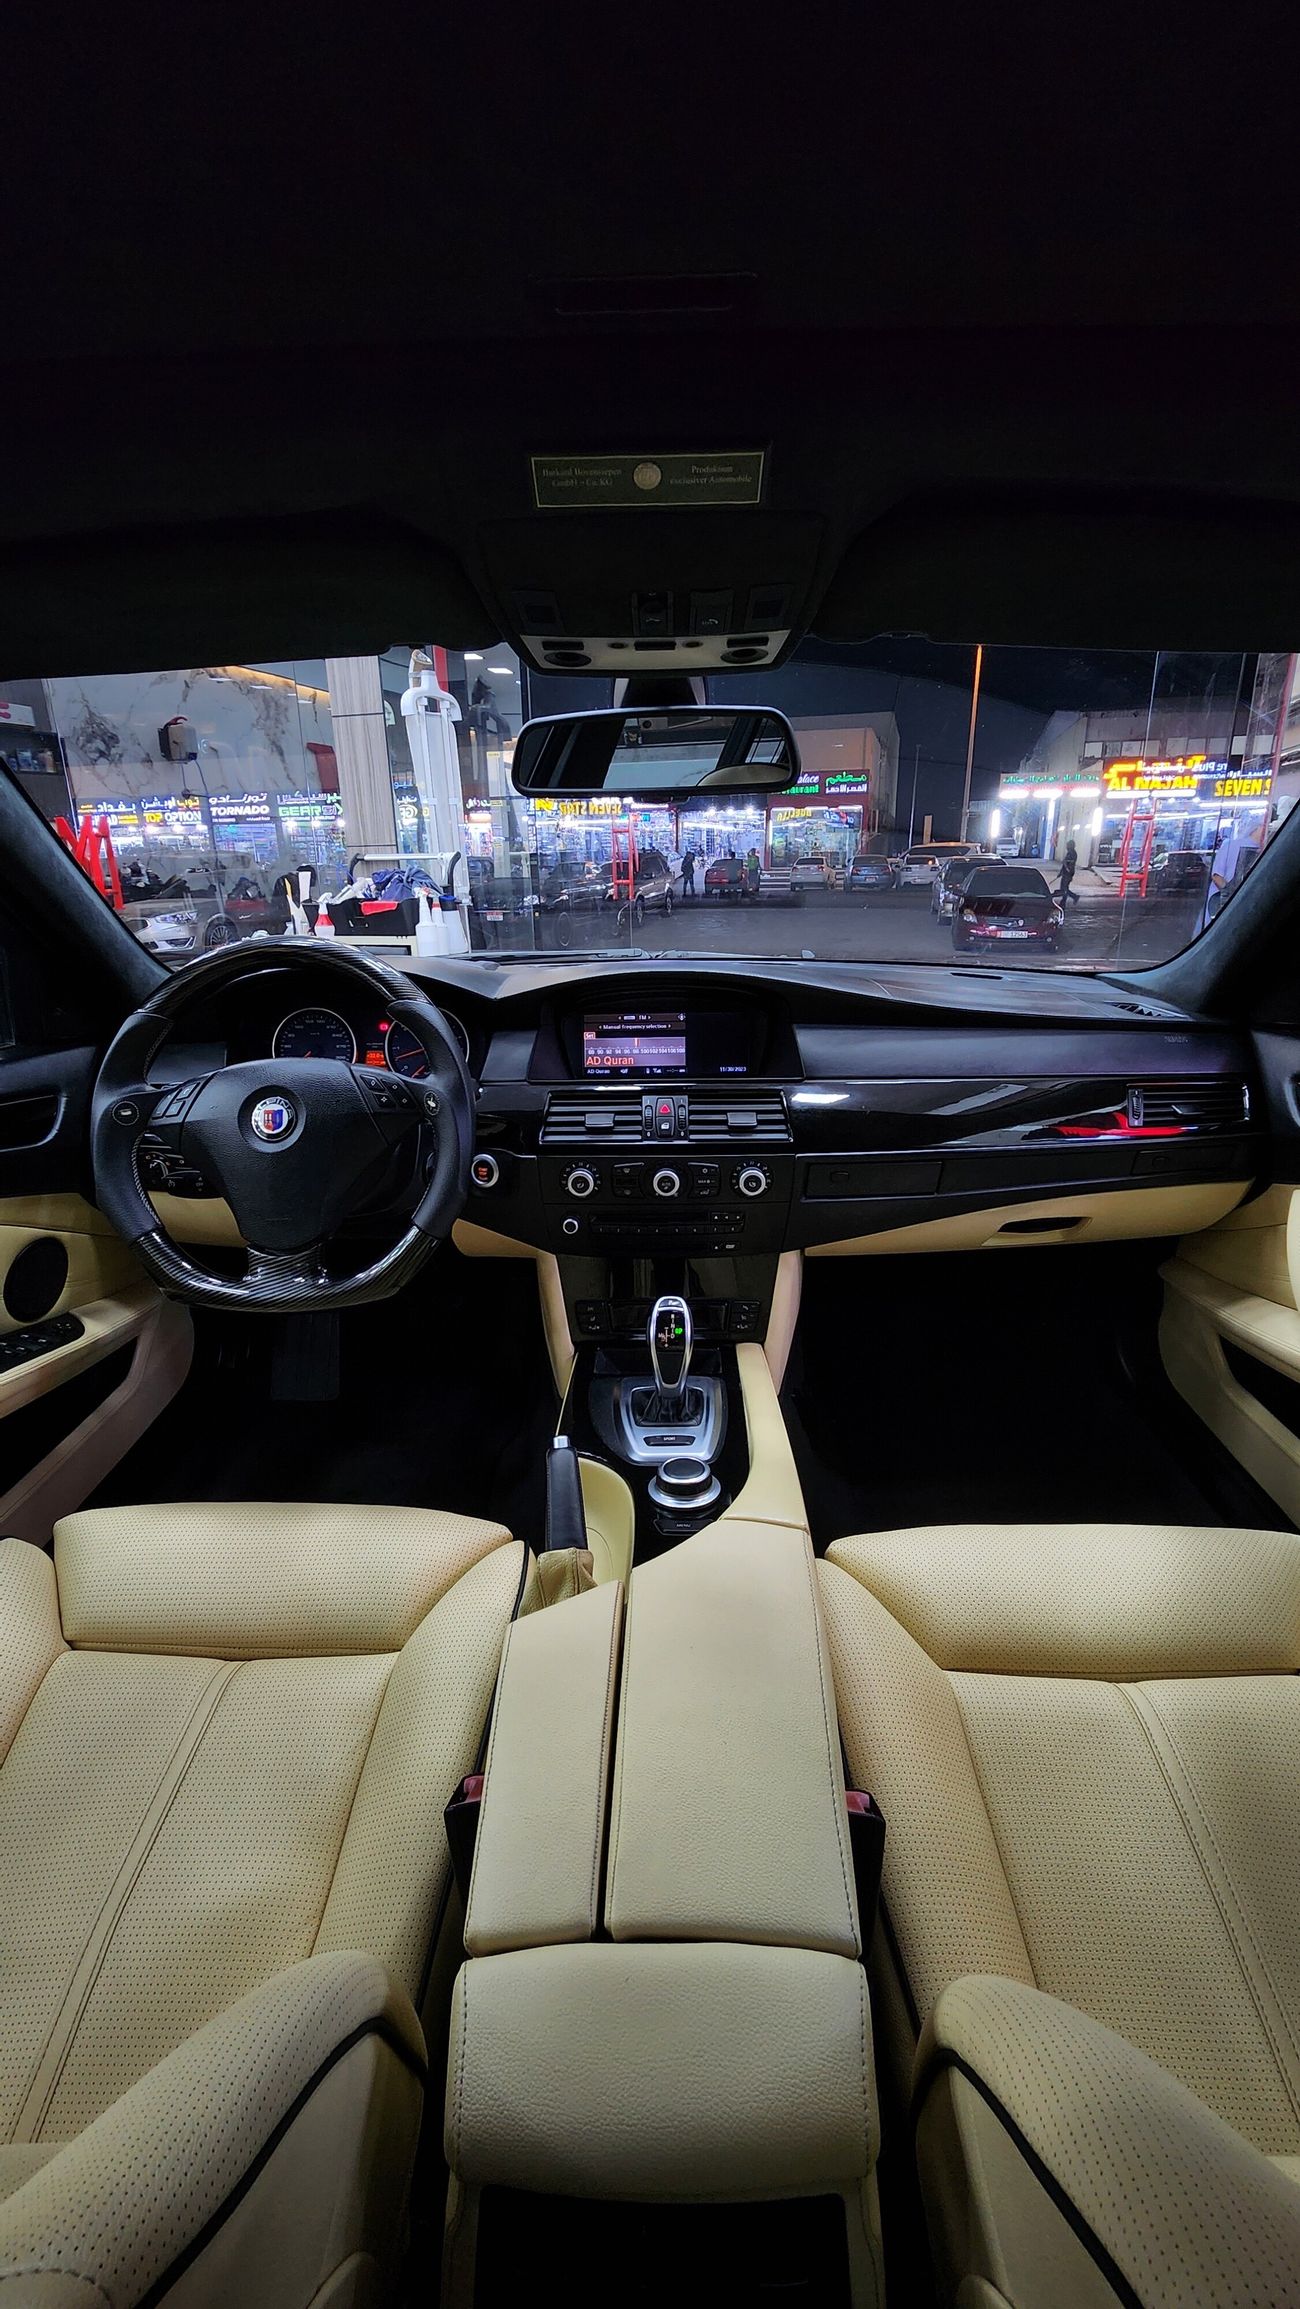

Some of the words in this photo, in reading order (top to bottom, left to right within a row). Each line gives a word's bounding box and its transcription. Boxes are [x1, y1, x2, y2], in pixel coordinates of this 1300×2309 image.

[797, 773, 820, 784] alace
[1107, 777, 1132, 791] AL
[1134, 774, 1199, 790] NAJAH
[1214, 780, 1262, 797] SEVEN
[144, 812, 163, 823] TOP
[165, 810, 202, 822] OPTION
[210, 805, 270, 817] TORNADO
[279, 806, 321, 817] GEAR
[586, 1057, 601, 1065] AD
[603, 1056, 634, 1065] Quran
